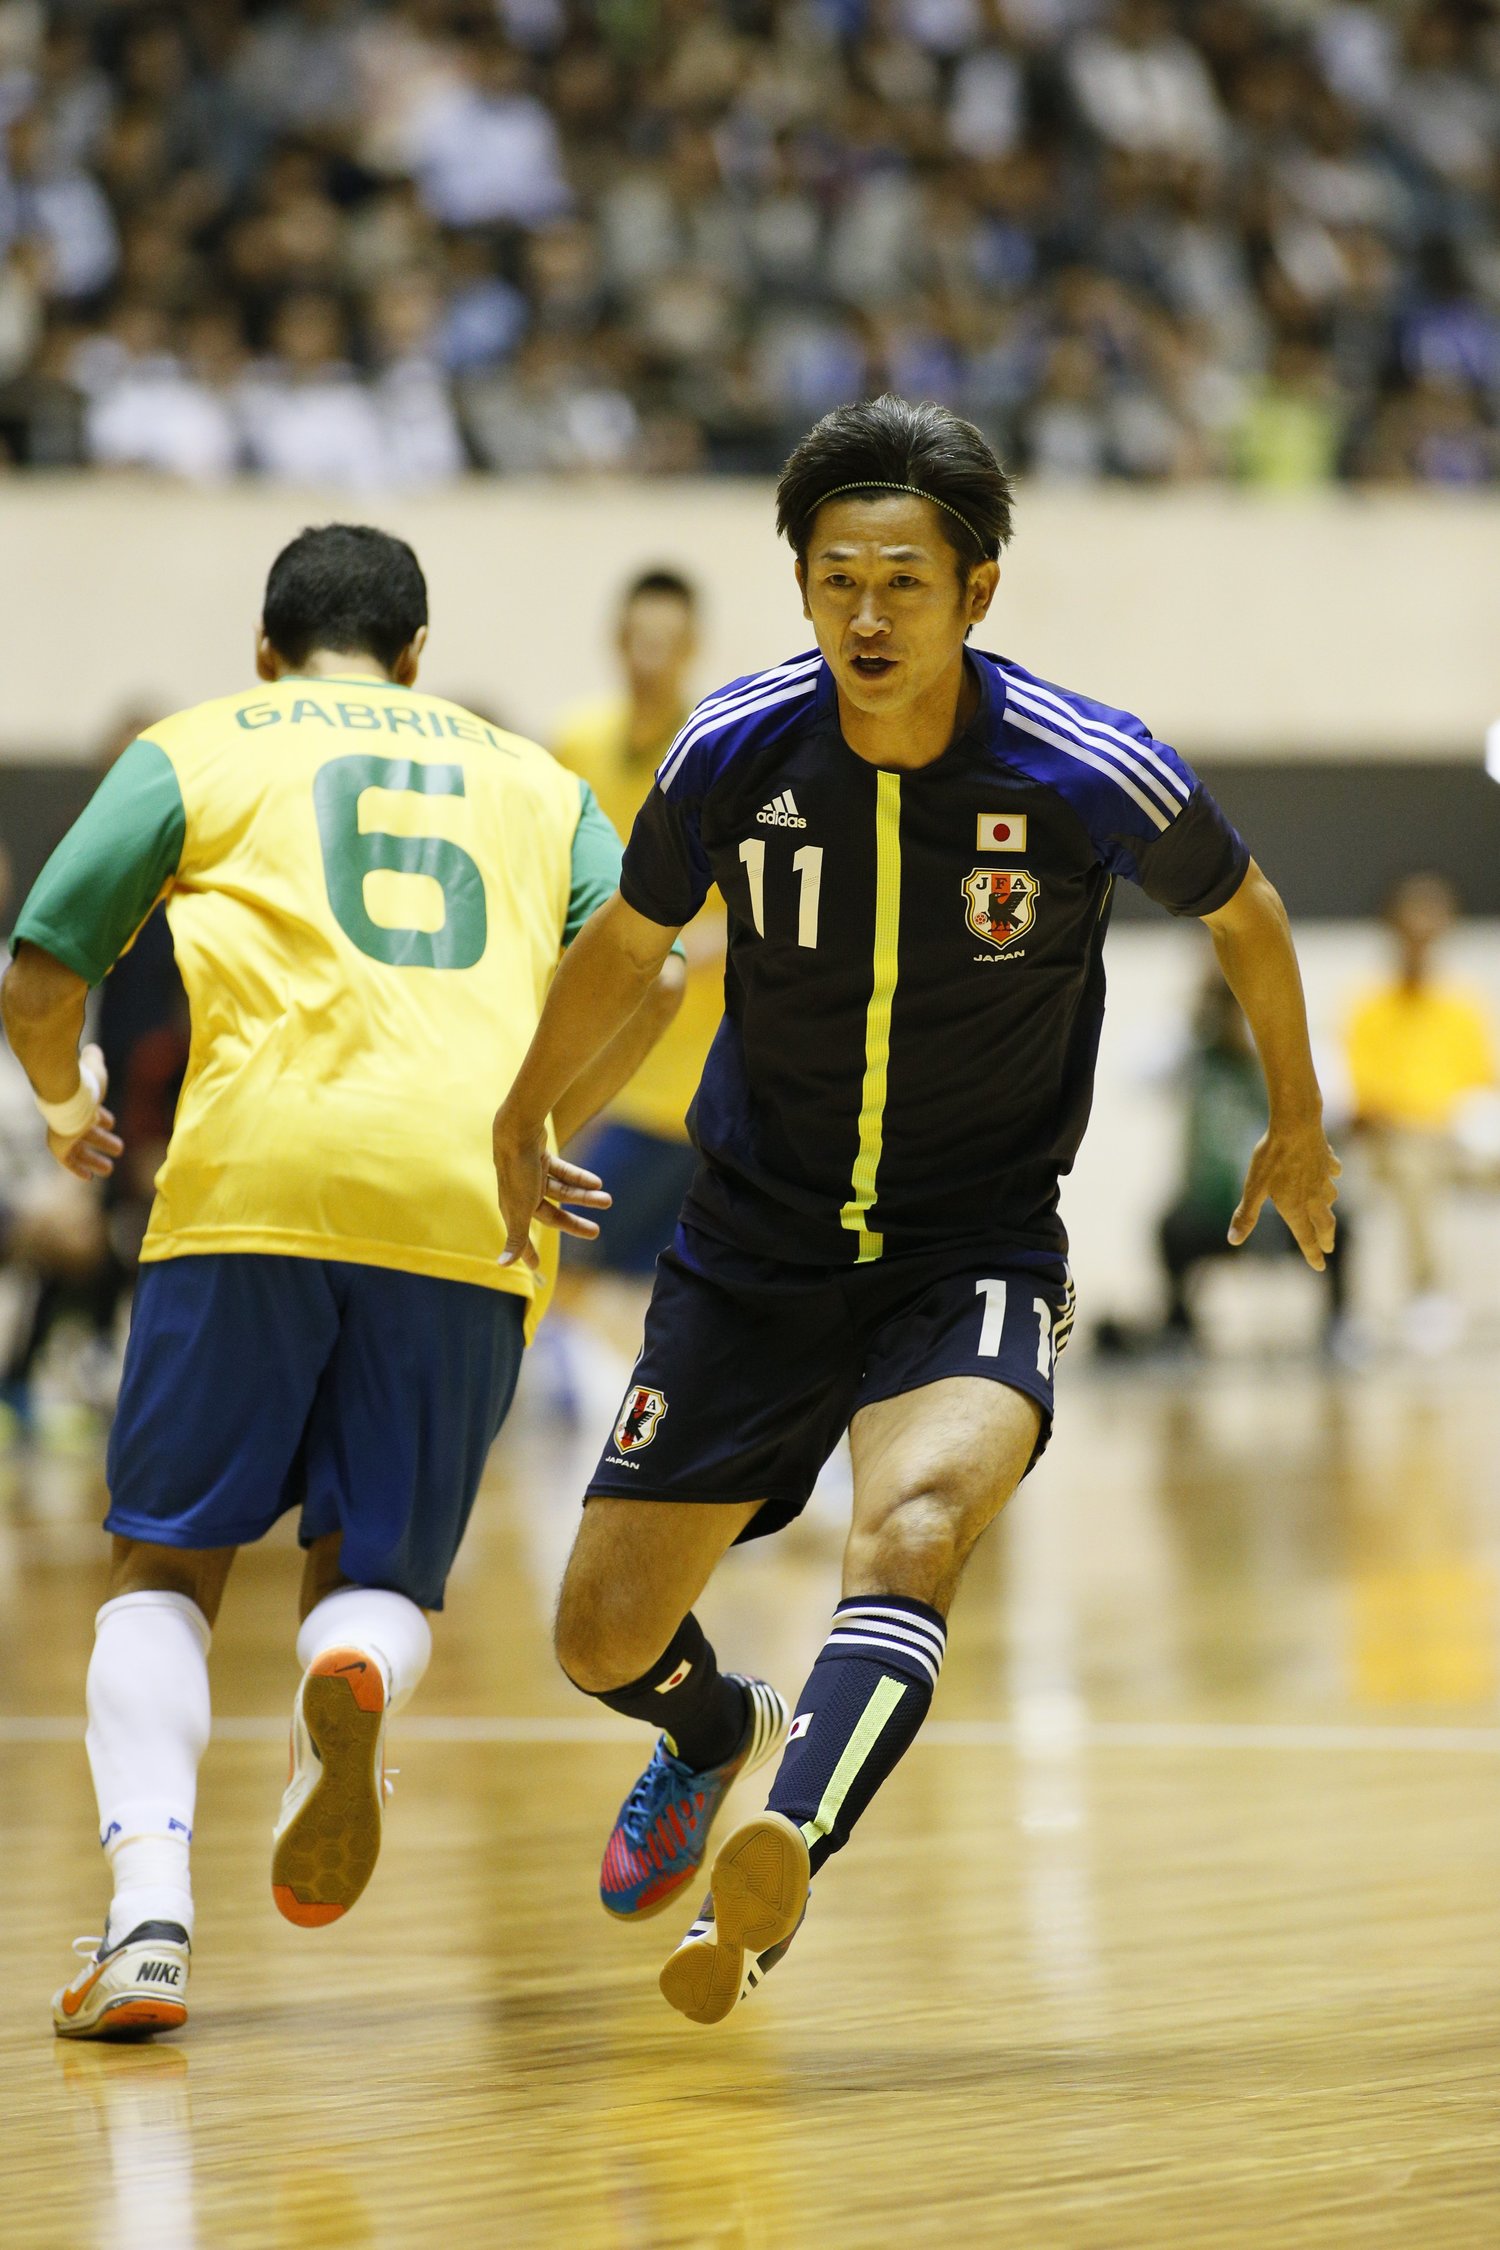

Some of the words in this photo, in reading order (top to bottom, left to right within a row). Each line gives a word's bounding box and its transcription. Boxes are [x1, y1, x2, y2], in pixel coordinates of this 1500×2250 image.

[235, 699, 521, 760] GABRIEL
[756, 811, 807, 829] adidas
[313, 754, 488, 970] 6
[738, 838, 823, 949] 11
[976, 877, 1027, 890] JFA
[973, 949, 1025, 963] JAPAN
[976, 1279, 1052, 1381] 11
[605, 1456, 640, 1470] JAPAN
[136, 1962, 181, 1986] NIKE
